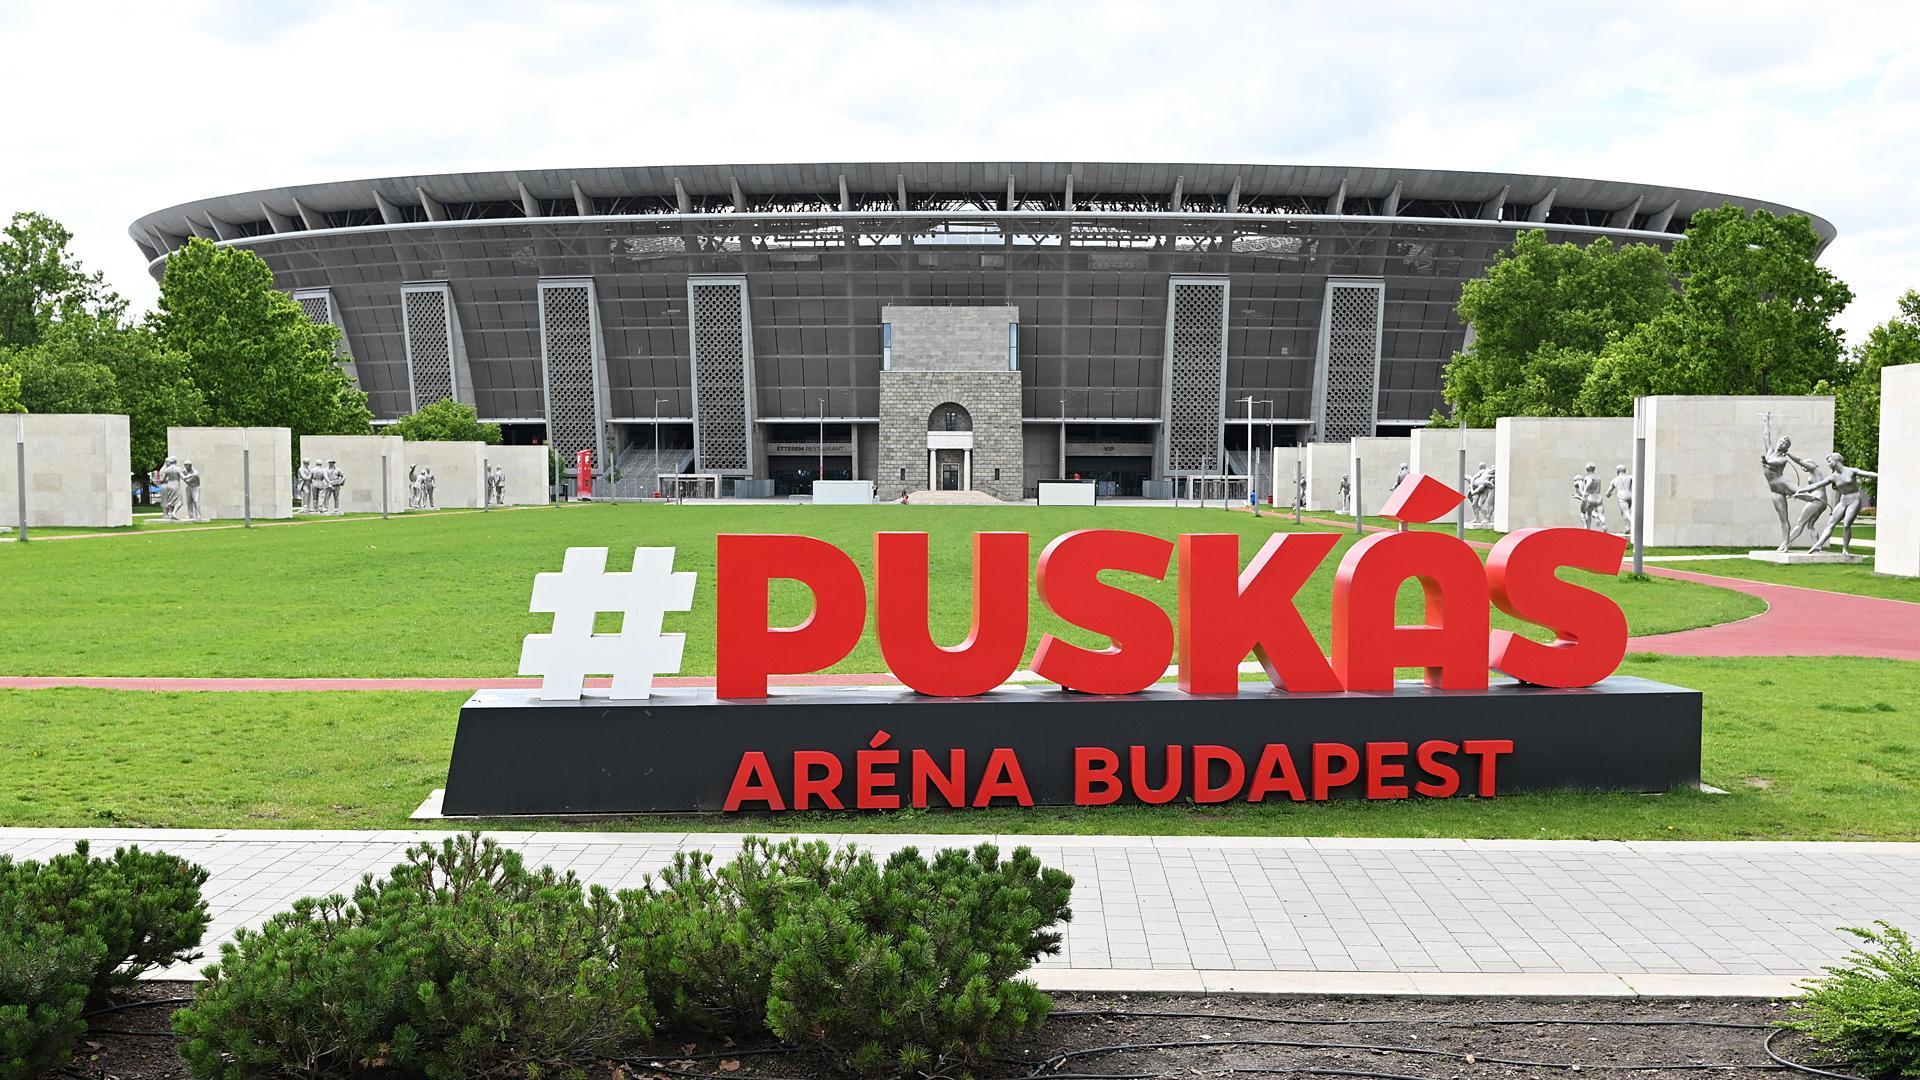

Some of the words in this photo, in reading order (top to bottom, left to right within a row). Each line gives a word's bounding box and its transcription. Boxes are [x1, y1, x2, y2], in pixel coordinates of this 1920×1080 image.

[518, 474, 1628, 699] #PUSKÁS
[723, 730, 1034, 811] ARÉNA
[1074, 739, 1514, 807] BUDAPEST
